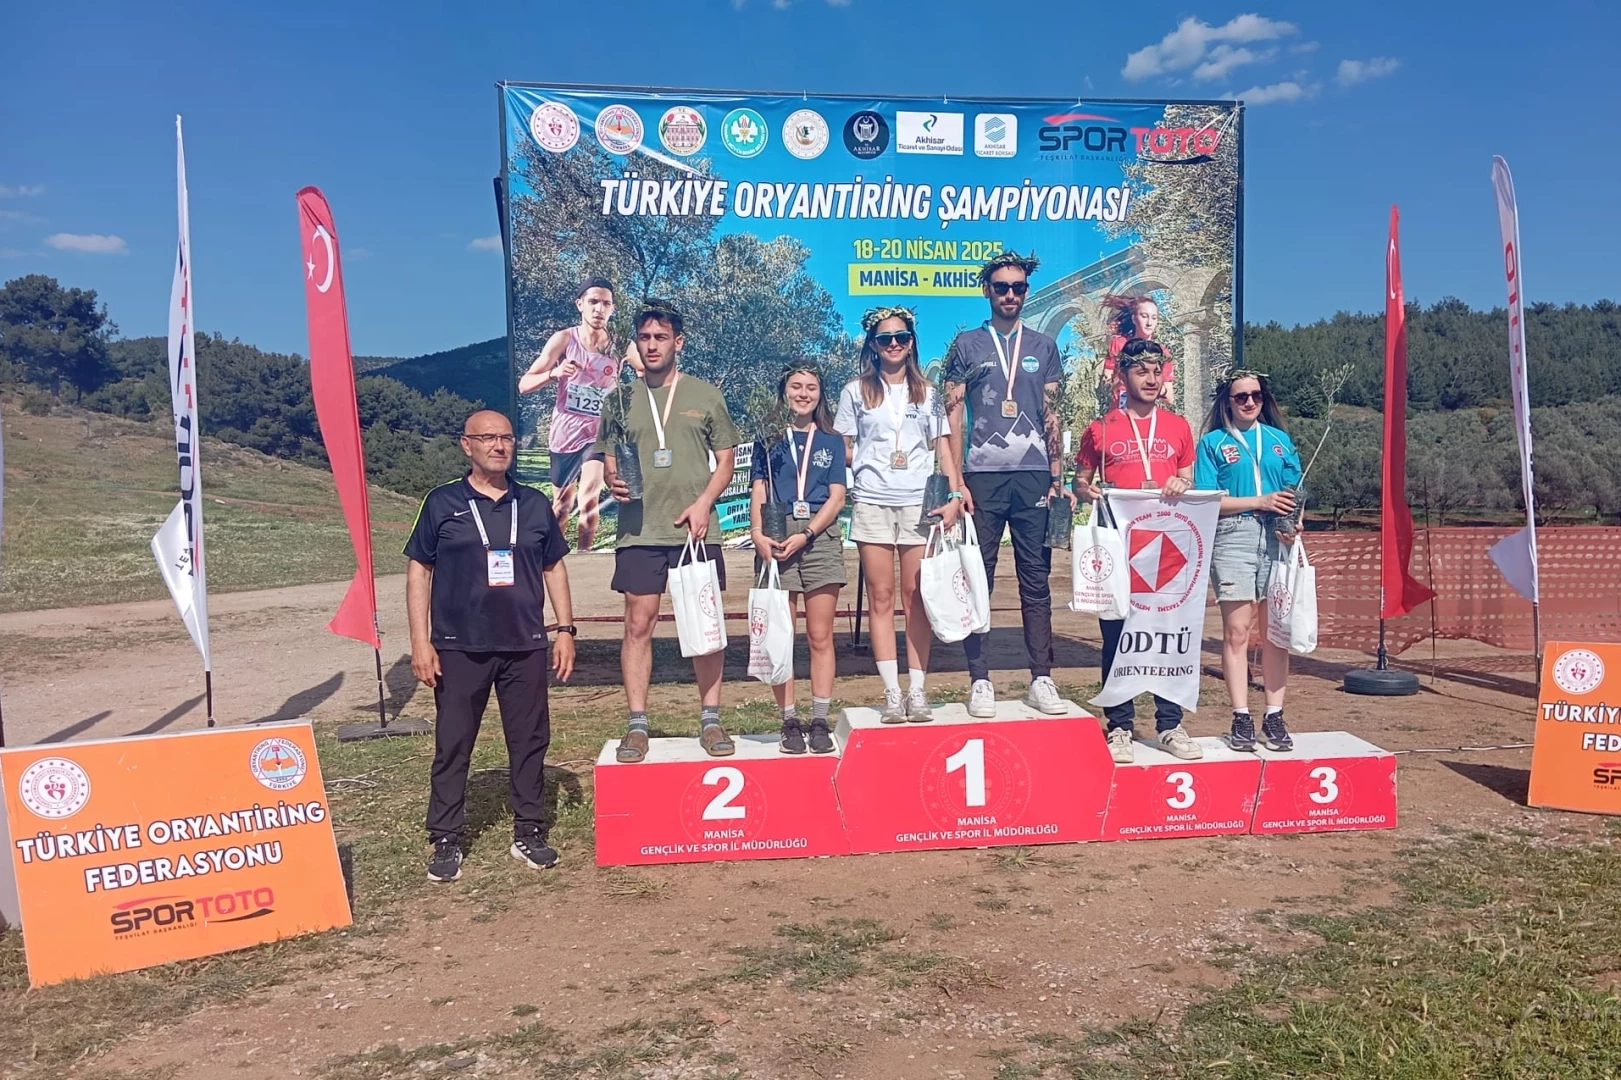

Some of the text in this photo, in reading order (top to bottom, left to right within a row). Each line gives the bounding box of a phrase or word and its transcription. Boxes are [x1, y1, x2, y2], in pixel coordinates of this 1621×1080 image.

[915, 136, 945, 145] Akhisar
[1038, 126, 1217, 153] SPOR TOTO
[600, 173, 1131, 230] TÜRKİYE ORYANTİRİNG ŞAMPİYONASI
[853, 236, 1003, 262] 18-20 NİSAN 2025
[859, 268, 919, 287] MANİSA
[575, 397, 602, 412] 123
[727, 504, 744, 516] ORTA
[1119, 627, 1192, 655] ODTÜ
[1114, 664, 1193, 678] ORIENTEERING
[1542, 700, 1621, 725] TÜRKİY
[947, 739, 986, 807] 1
[702, 767, 746, 821] 2
[1166, 771, 1197, 809] 3
[1309, 766, 1339, 804] 3
[957, 815, 997, 826] MANİSA
[1166, 813, 1197, 822] MANİSA
[1262, 814, 1386, 829] GENÇLİK VE SPOR İL MÜDÜRLÜĞÜ
[1309, 808, 1339, 816] MANİSA
[17, 800, 325, 863] TÜRKİYE ORYANTİRİNG
[704, 829, 744, 840] MANİSA
[896, 824, 1058, 843] GENÇLİK VE SPOR İL MÜDÜRLÜĞÜ
[1119, 819, 1245, 835] GENÇLİK VE SPOR İL MÜDÜRLÜĞÜ
[640, 838, 808, 857] GENÇLİK VE SPOR İL MÜDÜRLÜĞÜ
[85, 841, 282, 892] FEDERASYONU
[111, 887, 274, 934] SPOR TOTO
[115, 922, 198, 940] TEŞKİLAT BAŞKANLIĞI
